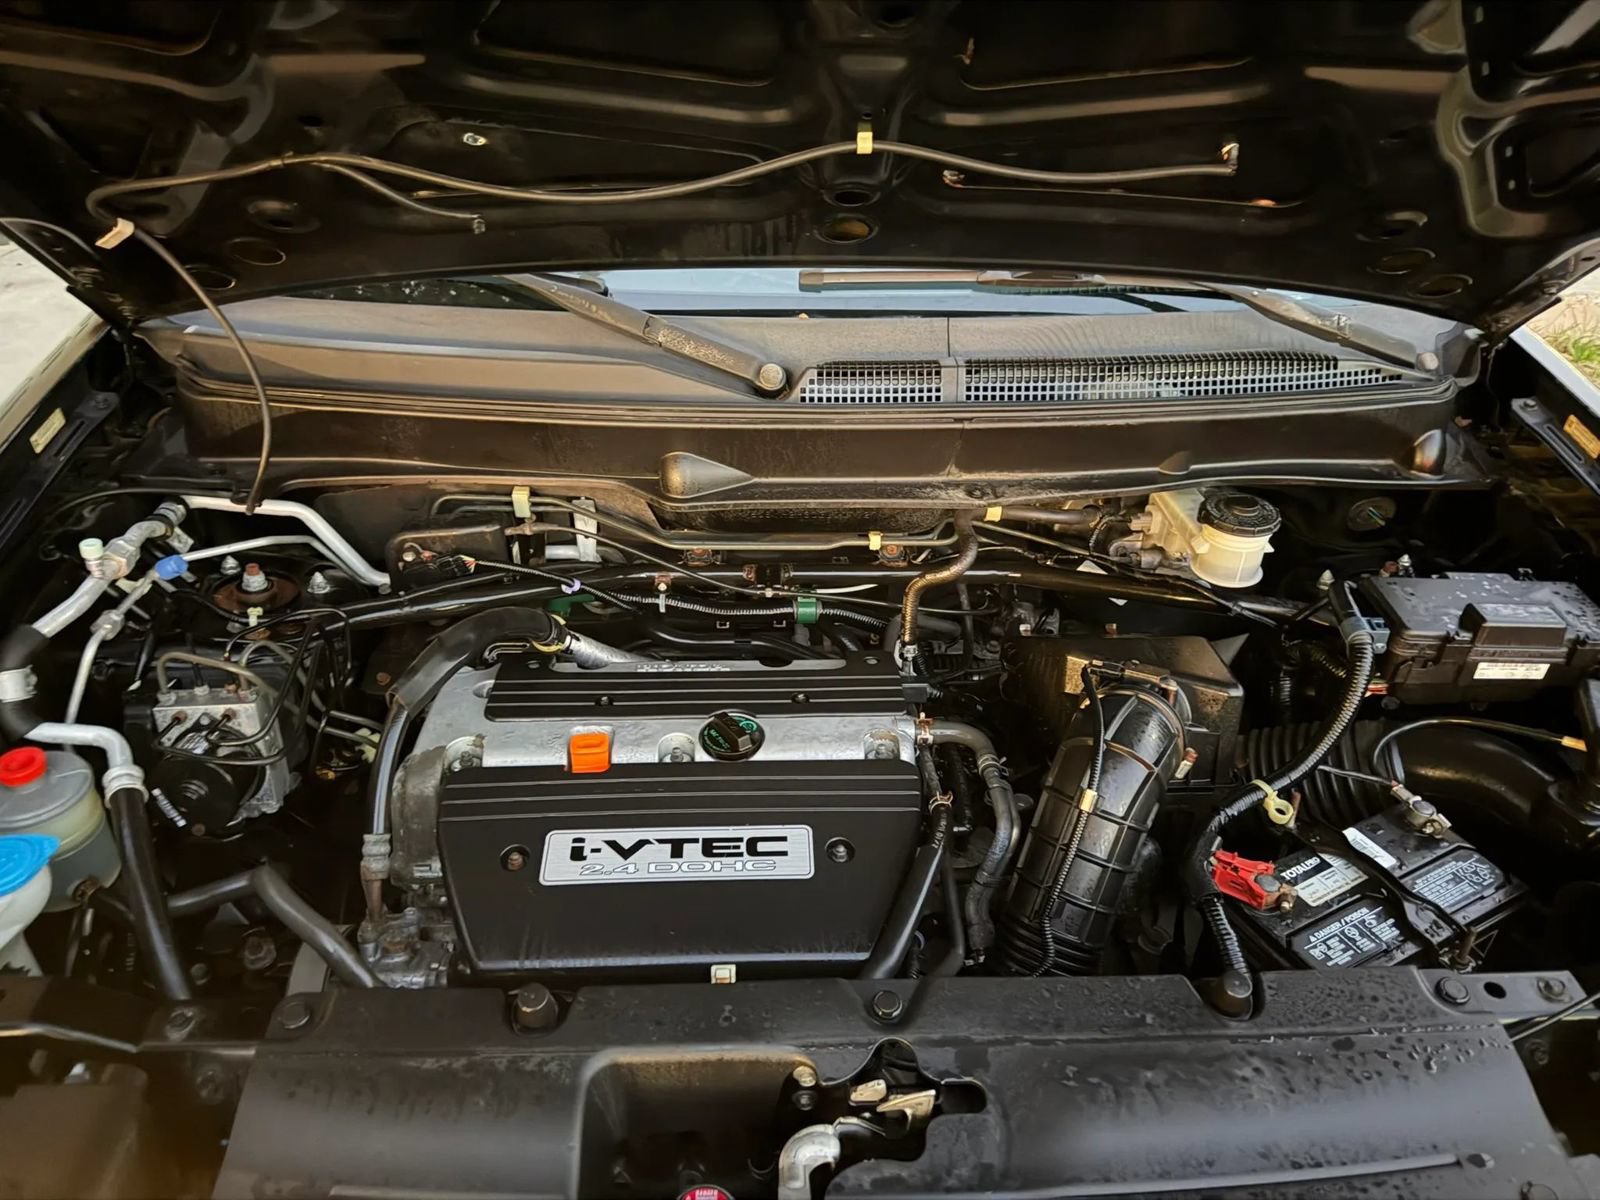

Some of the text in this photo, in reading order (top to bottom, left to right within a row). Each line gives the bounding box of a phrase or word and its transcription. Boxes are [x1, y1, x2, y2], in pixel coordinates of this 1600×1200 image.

[569, 836, 788, 862] i-VTEC
[579, 860, 776, 876] 2.4 DOHC
[1314, 921, 1342, 939] DANGER
[1344, 907, 1370, 924] POISON
